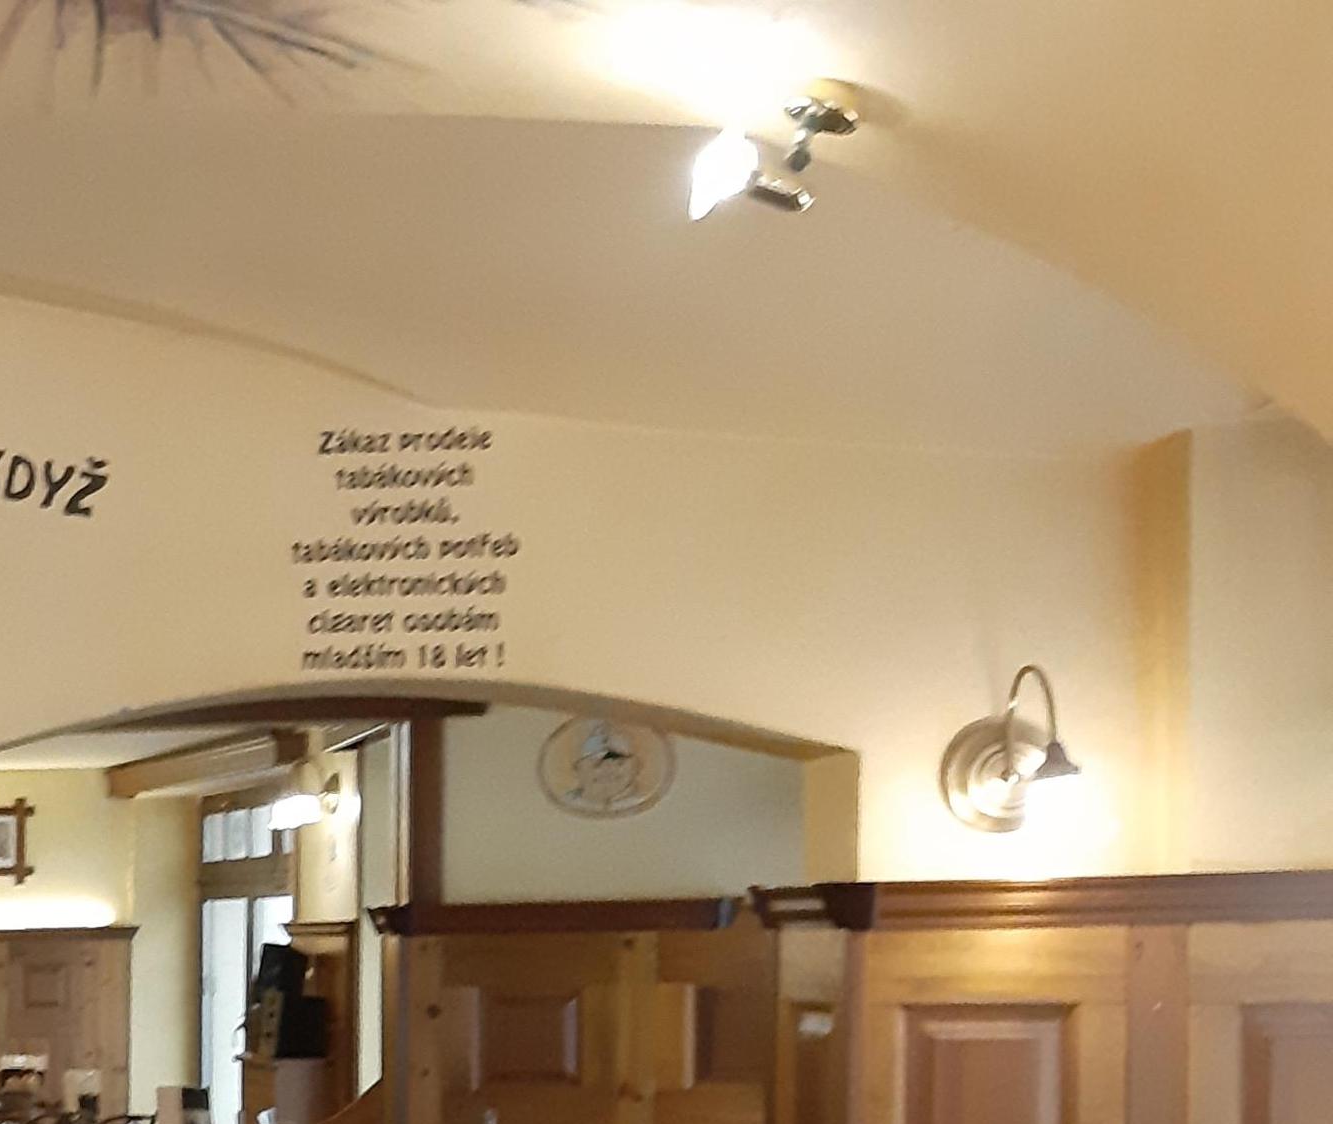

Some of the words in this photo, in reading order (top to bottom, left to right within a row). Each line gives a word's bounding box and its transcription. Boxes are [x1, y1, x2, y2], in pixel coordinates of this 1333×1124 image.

[317, 428, 391, 454] Zákaz
[398, 426, 493, 451] prodeje
[335, 461, 474, 489] tabákových
[292, 536, 430, 563] tabákových
[439, 532, 521, 559] potřeb
[303, 578, 317, 598] a
[327, 571, 507, 597] elektronických
[307, 608, 393, 634] cigaret
[403, 605, 499, 632] osobám
[302, 643, 405, 670] mladším
[419, 644, 446, 668] 18
[455, 642, 487, 668] let
